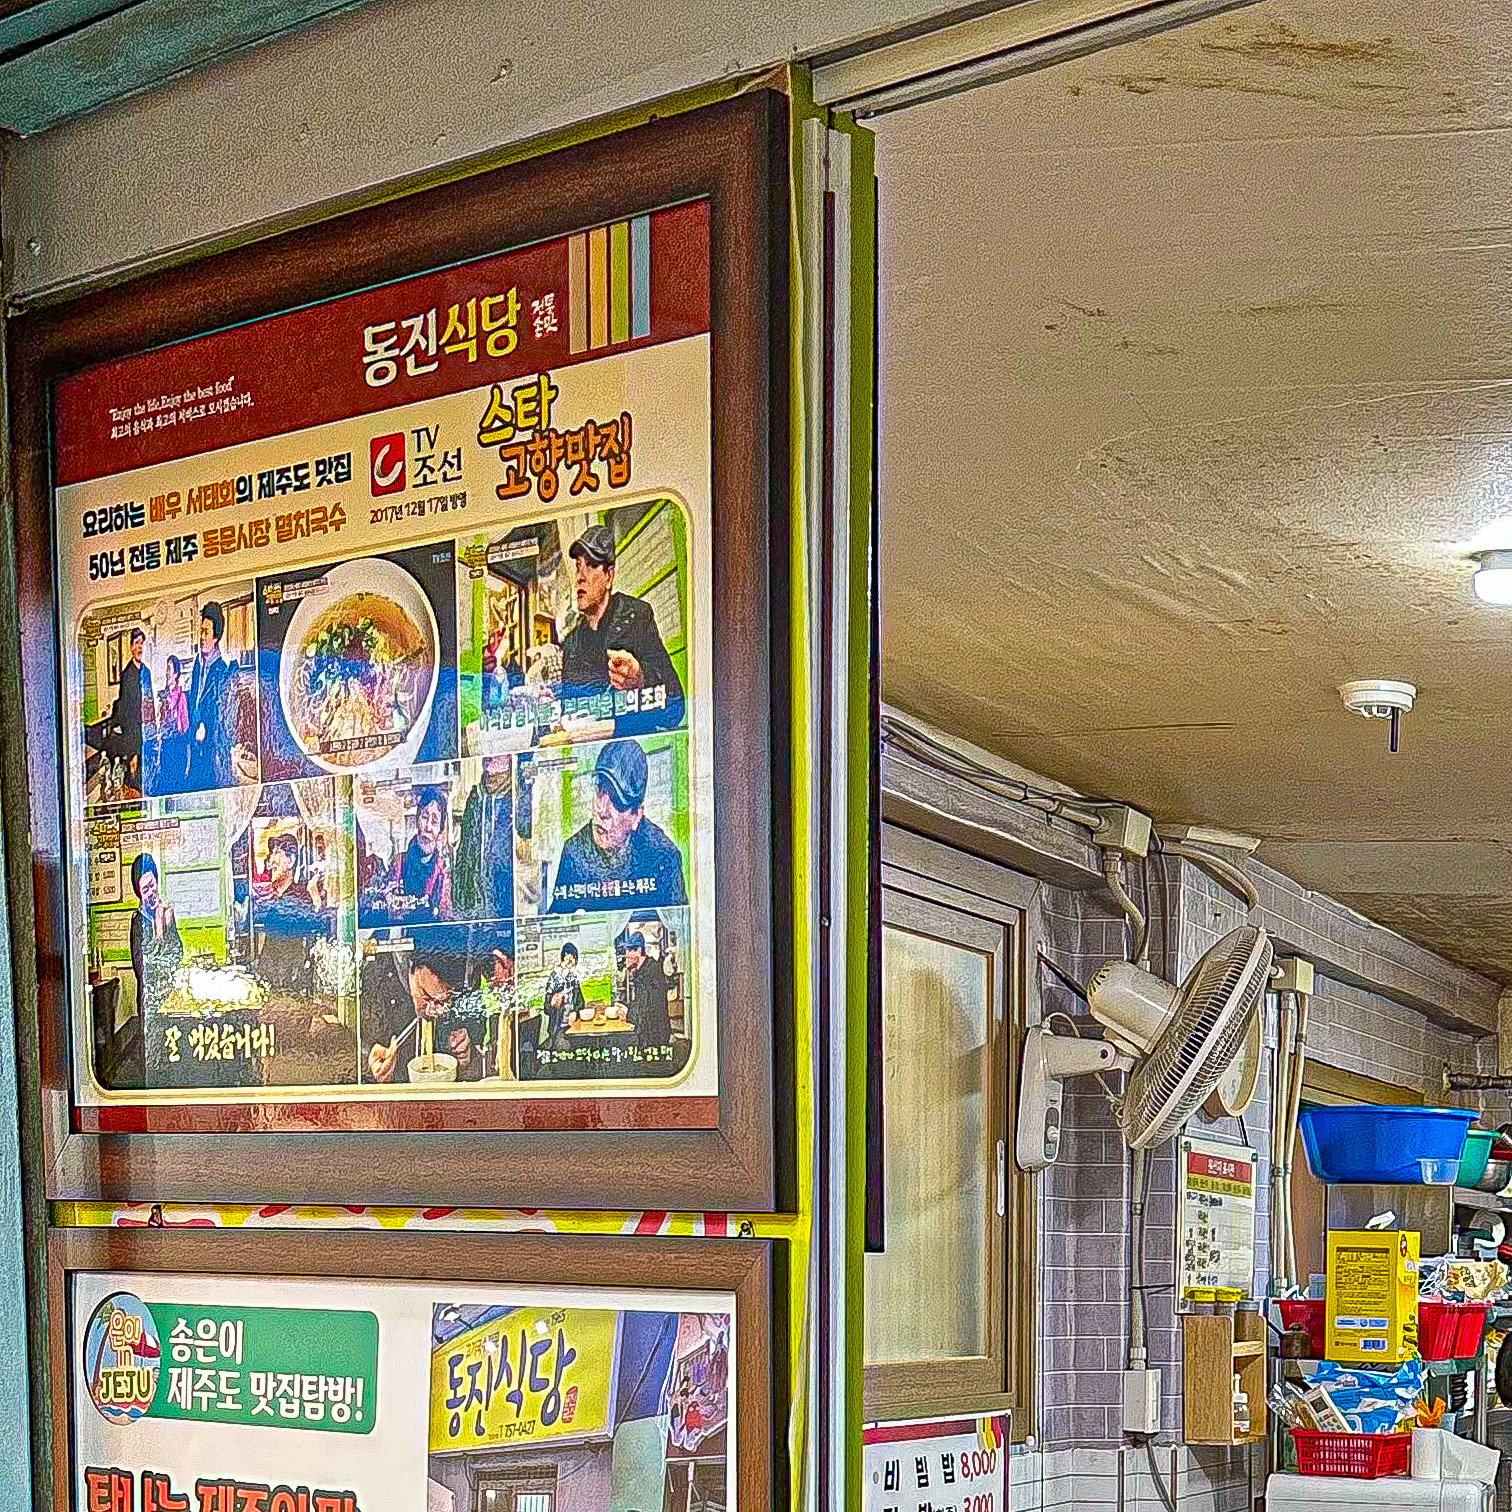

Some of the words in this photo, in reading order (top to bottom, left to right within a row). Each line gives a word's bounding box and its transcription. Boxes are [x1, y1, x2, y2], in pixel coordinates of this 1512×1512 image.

[363, 287, 522, 388] 동진식당
[477, 373, 558, 446] 스타
[412, 424, 440, 450] TV
[496, 412, 634, 502] 고향맛집
[412, 447, 463, 489] 조선
[81, 500, 146, 539] 요리하는
[149, 491, 182, 523] 배우
[186, 474, 254, 516] 서태화의
[257, 462, 311, 500] 제주도
[315, 452, 352, 485] 맛집
[88, 548, 126, 581] 50년
[129, 541, 162, 572] 전통
[165, 533, 199, 566] 제주
[203, 515, 272, 558] 동문시장
[275, 502, 347, 543] 멸치국수
[640, 684, 667, 711] 조화
[164, 1024, 182, 1063] 잘
[188, 1023, 275, 1062] 먹었습니다!
[110, 1309, 142, 1347] 은이
[168, 1318, 245, 1365] 송은이
[100, 1367, 153, 1403] JEJU
[167, 1366, 243, 1413] 제주도
[249, 1370, 366, 1423] 맛집탐방!
[446, 1328, 577, 1438] 동진식당
[960, 1449, 997, 1482] 8,000
